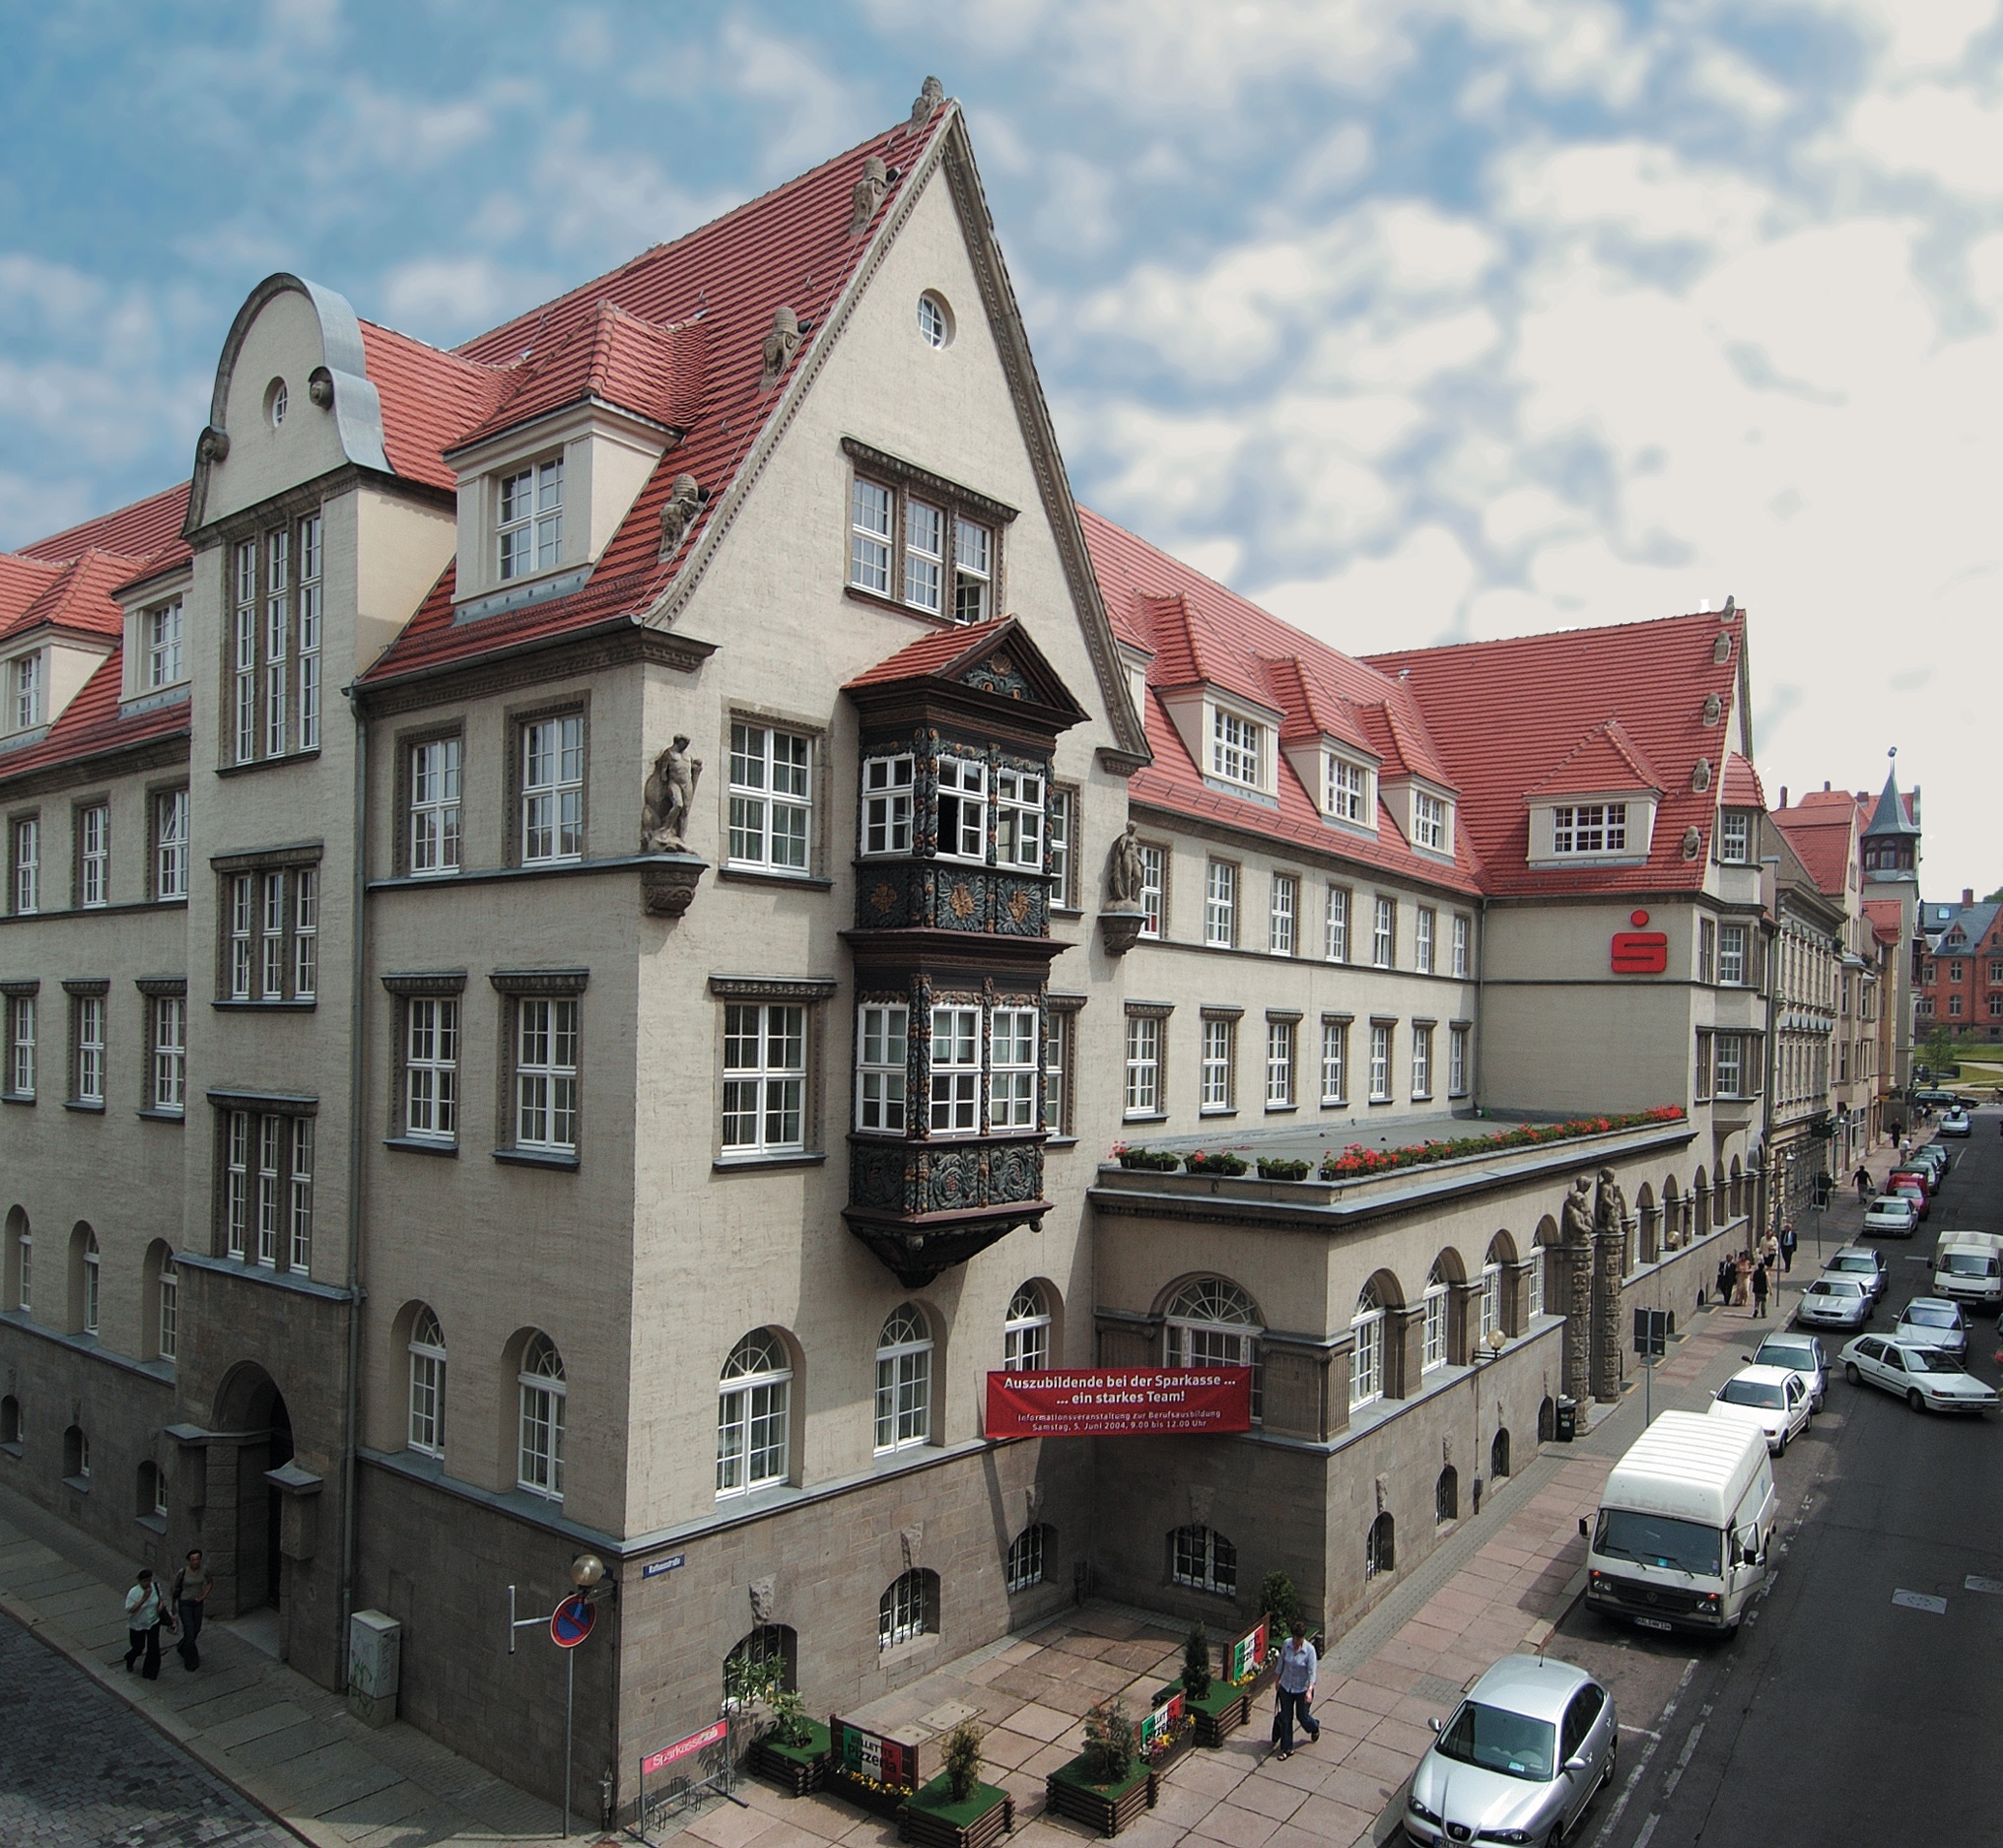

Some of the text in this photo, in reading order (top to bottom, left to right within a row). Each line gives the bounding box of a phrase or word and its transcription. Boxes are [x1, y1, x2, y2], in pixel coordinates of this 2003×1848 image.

[1003, 1376, 1103, 1390] Auszubildende
[1107, 1375, 1127, 1388] bei
[1131, 1375, 1152, 1388] der
[1154, 1374, 1221, 1389] Sparkasse
[1071, 1392, 1092, 1404] ein
[1095, 1391, 1144, 1403] starkes
[1146, 1390, 1185, 1403] Team!
[1018, 1411, 1130, 1422] Informationsveranstaltung
[1148, 1409, 1221, 1420] Berufsausbildung
[1032, 1423, 1071, 1432] Samstag,
[1084, 1421, 1102, 1430] Juni
[1104, 1421, 1129, 1430] 2004,
[1130, 1420, 1148, 1429] 9.00
[1166, 1419, 1190, 1428] 12.00
[848, 1744, 897, 1773] Pizzeria
